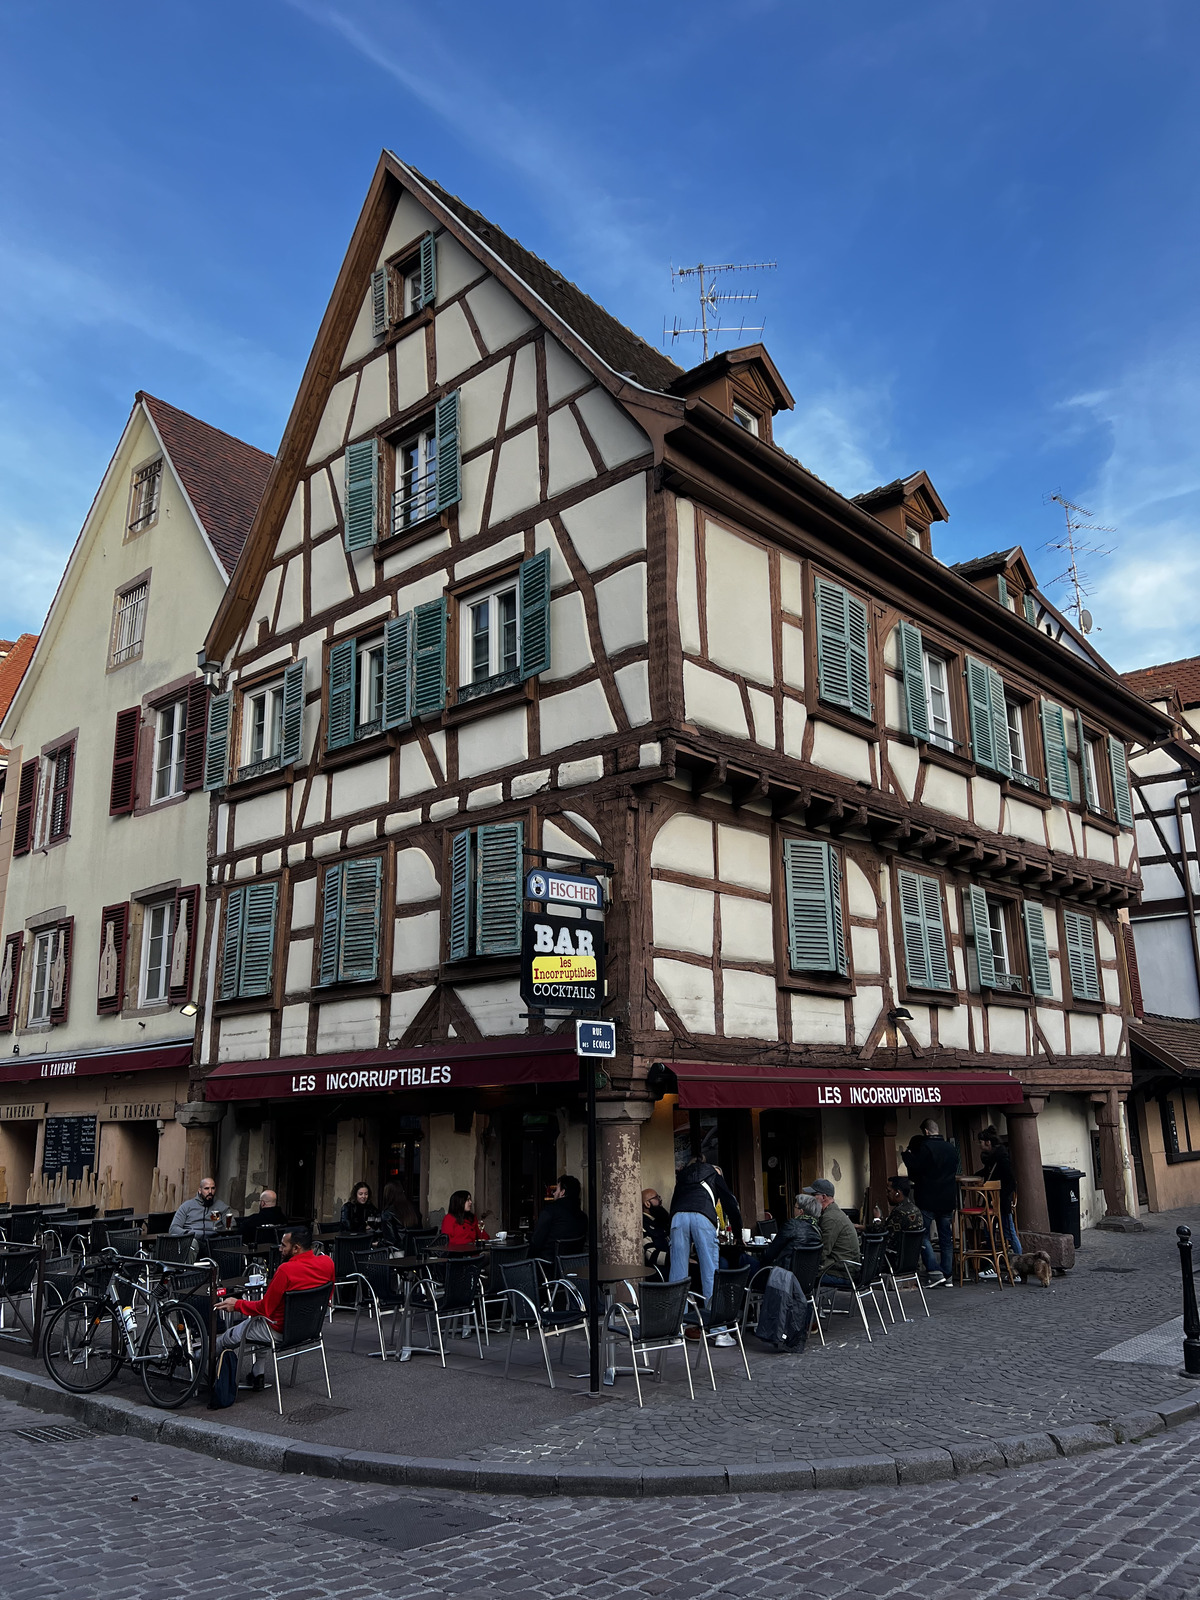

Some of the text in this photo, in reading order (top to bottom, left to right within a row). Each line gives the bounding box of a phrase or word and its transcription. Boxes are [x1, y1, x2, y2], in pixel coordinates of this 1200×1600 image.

[550, 881, 596, 902] FISCHER
[533, 923, 596, 957] BAR
[560, 957, 572, 968] les
[533, 967, 596, 981] Incorruptibles
[533, 983, 596, 1000] COCKTAILS
[592, 1027, 602, 1036] RUE
[592, 1040, 611, 1049] ECOLES
[41, 1061, 77, 1077] LA TAVERNE
[292, 1065, 452, 1092] LES INCORRUPTIBLES
[817, 1086, 941, 1104] LES INCORRUPTIBLES
[6, 1105, 35, 1119] TAVERNE
[109, 1103, 162, 1119] LA TAVERNE
